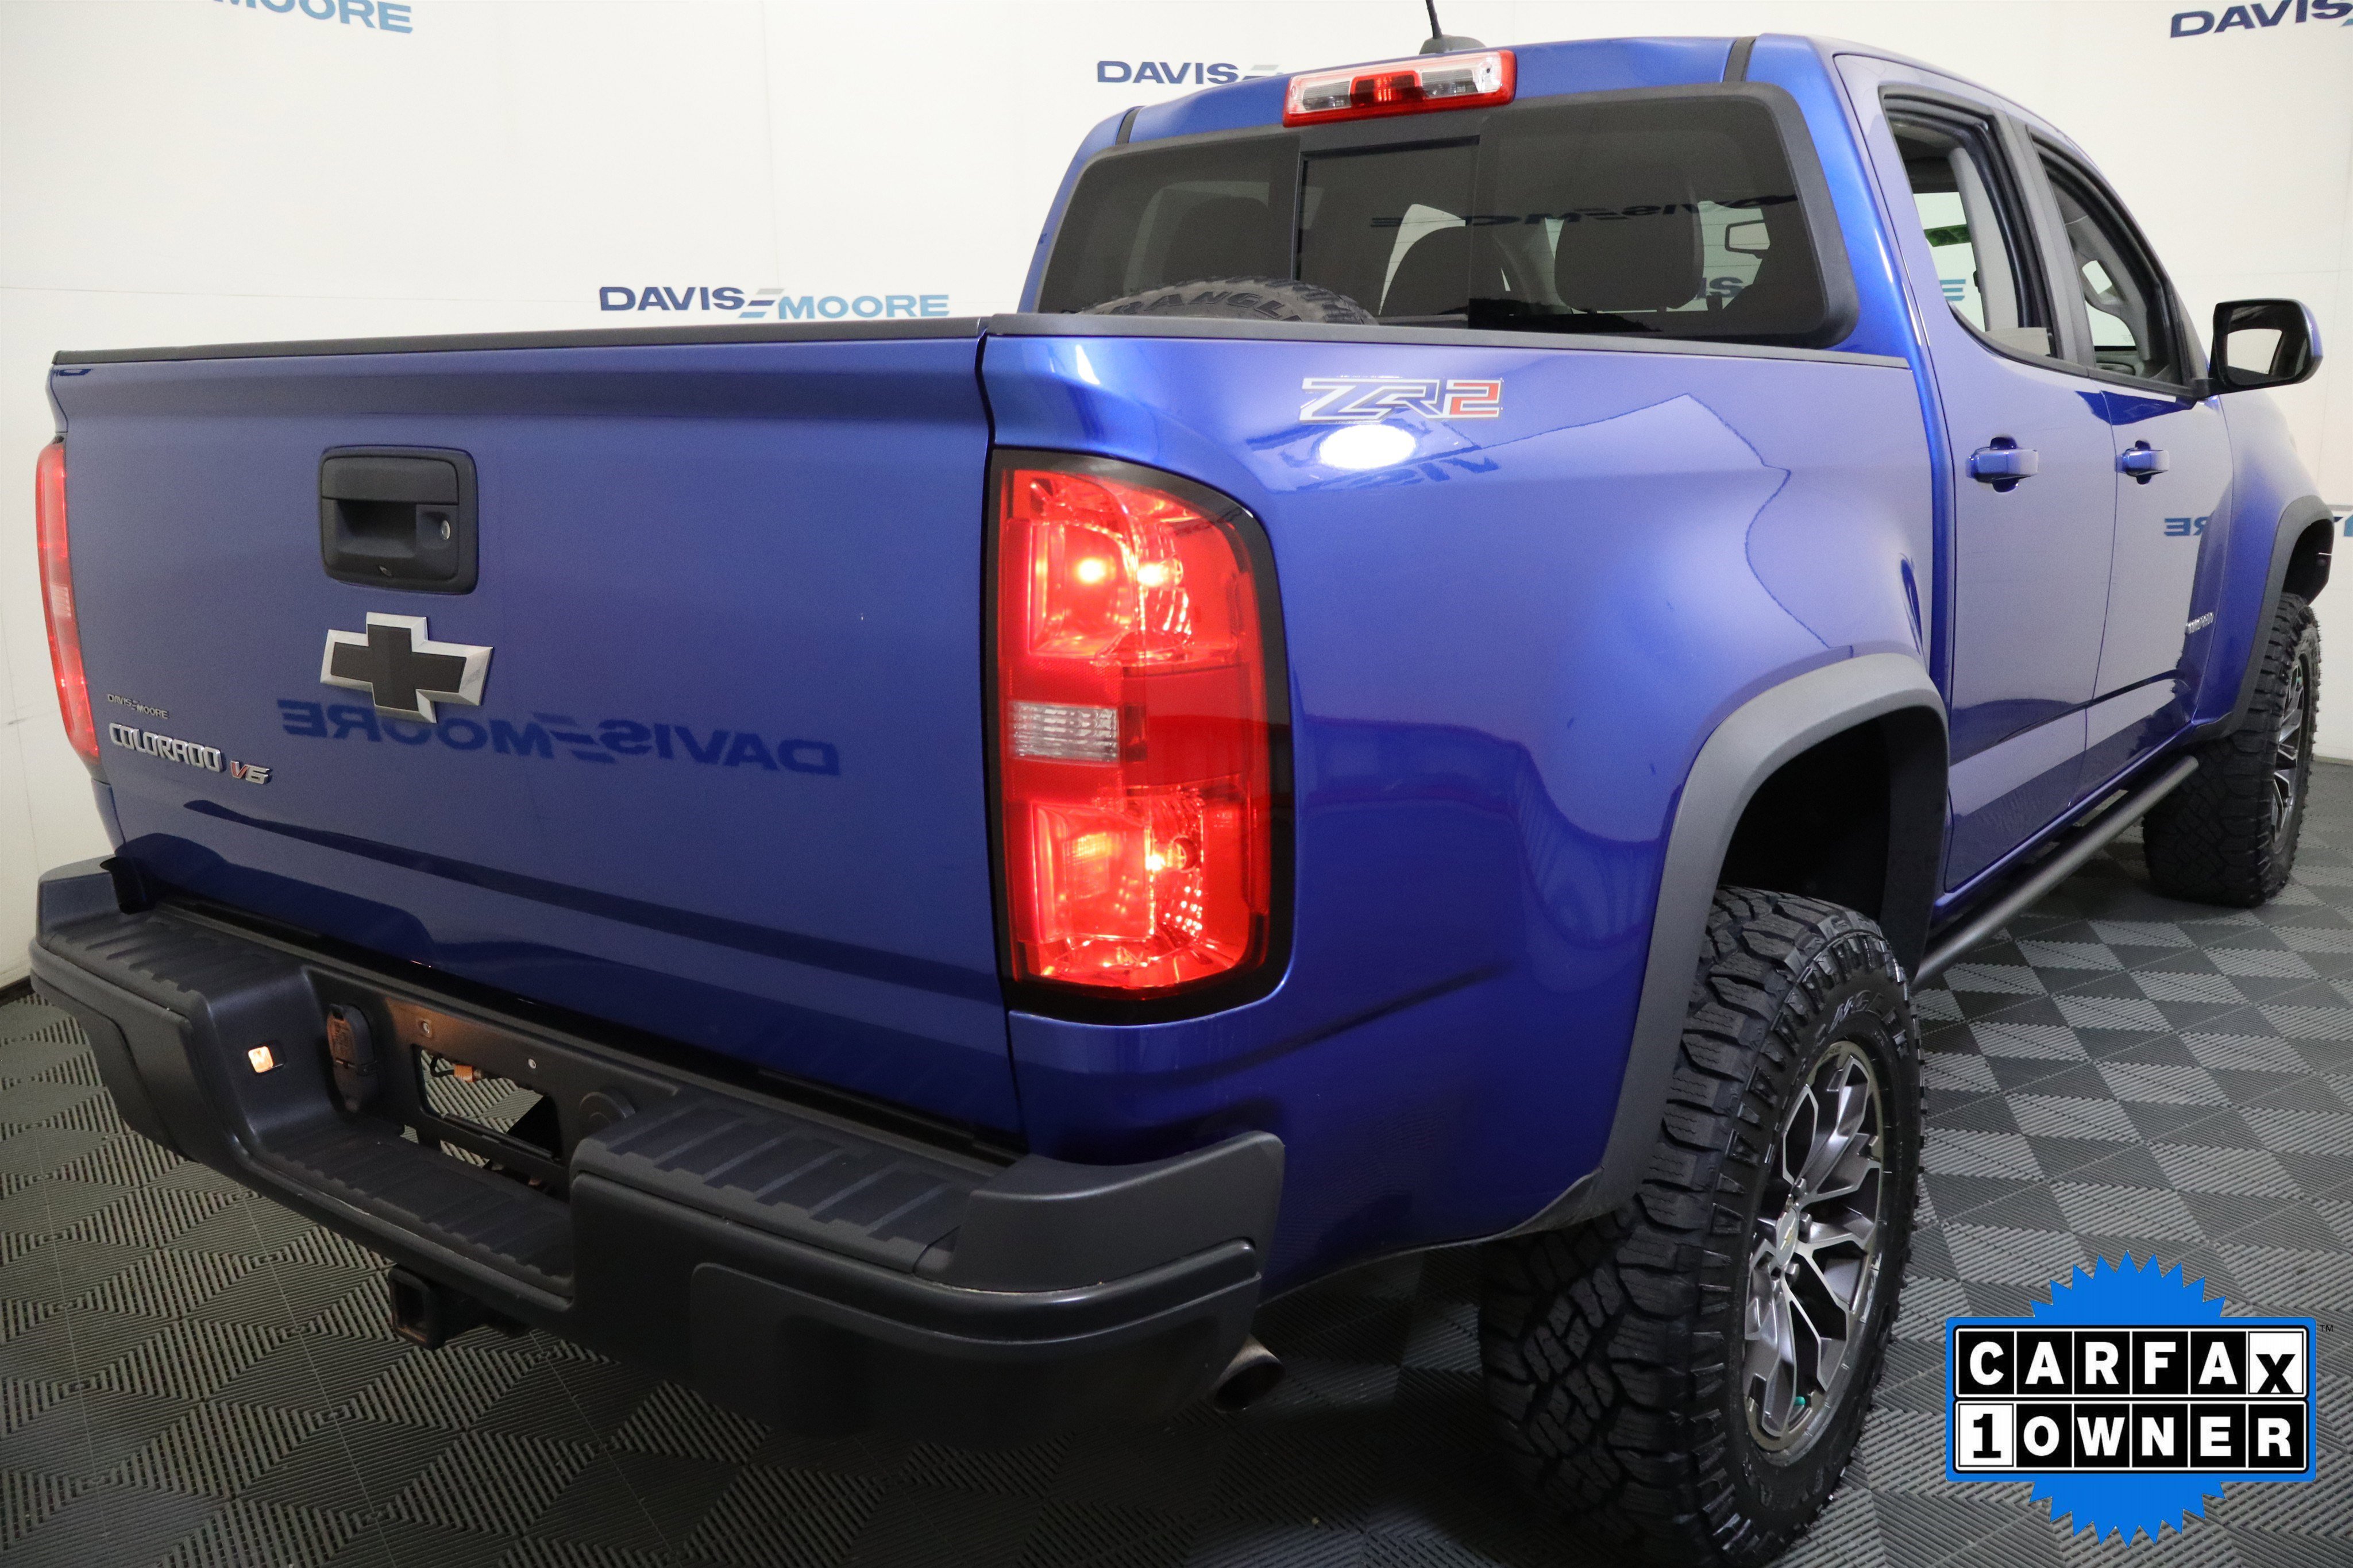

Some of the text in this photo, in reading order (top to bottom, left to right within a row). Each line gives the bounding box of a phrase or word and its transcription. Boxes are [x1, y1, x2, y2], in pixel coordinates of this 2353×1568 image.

[229, 0, 413, 34] ORE
[2170, 0, 2353, 38] DAVIS
[1097, 60, 1239, 84] DAVIS
[599, 287, 950, 319] DAVIS MOORE
[1108, 291, 1303, 322] RANGL
[1299, 377, 1502, 422] ZR2
[107, 694, 169, 719] DAVIS MOORE
[109, 722, 270, 785] COLORADO V6
